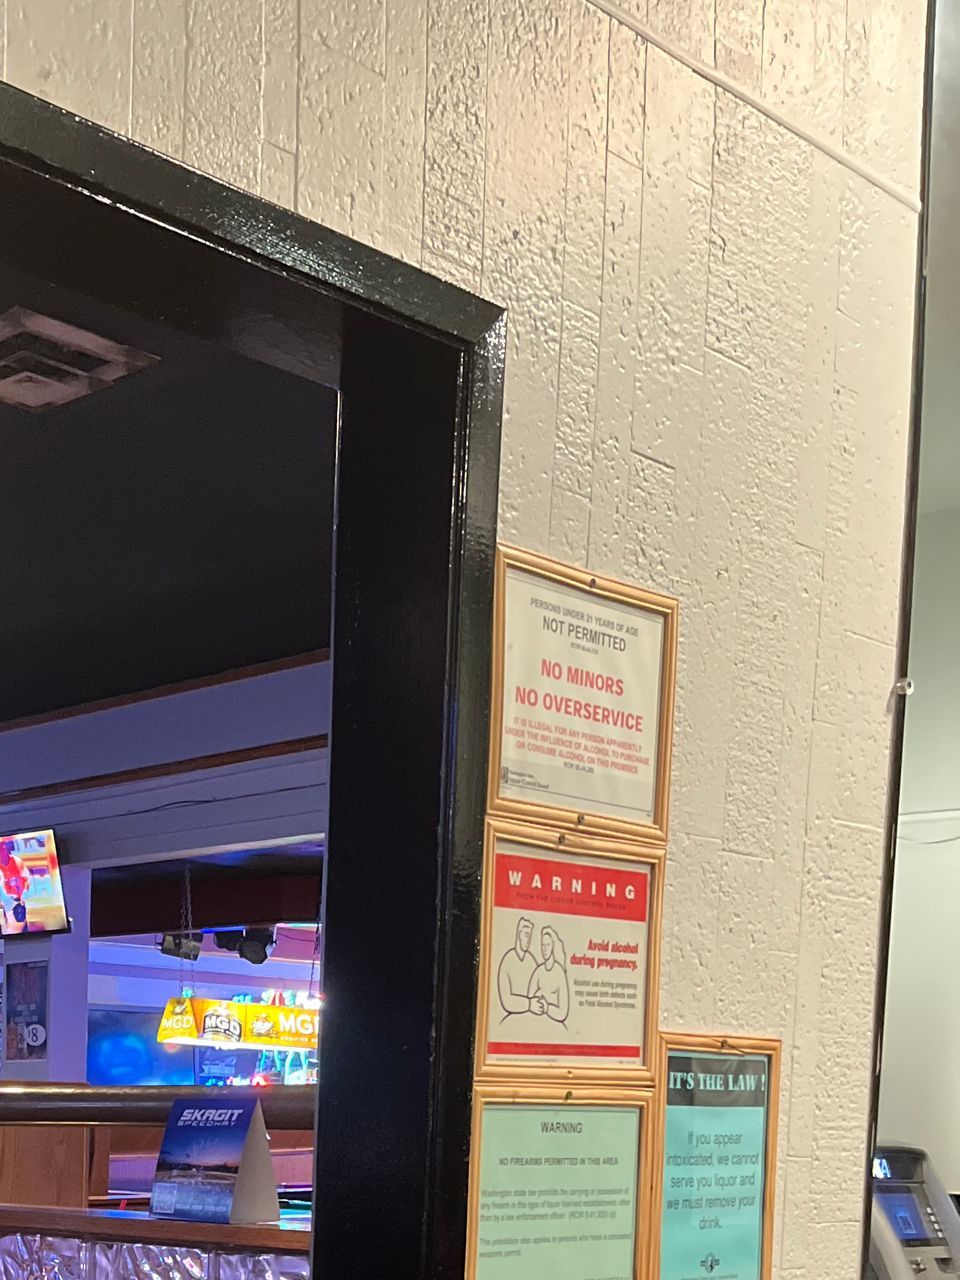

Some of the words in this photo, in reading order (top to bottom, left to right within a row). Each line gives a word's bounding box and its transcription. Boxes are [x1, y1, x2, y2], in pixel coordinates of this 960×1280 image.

[530, 597, 561, 614] PERSONS
[563, 608, 585, 620] UNDER
[586, 614, 593, 623] 21
[595, 616, 614, 631] YEARS
[616, 623, 625, 631] OF
[626, 626, 639, 636] AGE
[543, 616, 565, 635] NOT
[568, 623, 626, 652] PERMITTED
[541, 658, 562, 681] NO
[567, 665, 624, 696] MINORS
[515, 686, 538, 707] NO
[543, 692, 643, 732] OVERSERVICE
[508, 870, 635, 900] WARNING
[587, 938, 609, 952] Avoid
[611, 941, 638, 954] alcohol
[570, 953, 595, 968] during
[597, 957, 638, 972] pregnancy.
[162, 1015, 193, 1029] MGD
[204, 1014, 241, 1036] MGD
[669, 1071, 694, 1090] IT'S
[698, 1073, 724, 1091] THE
[728, 1074, 758, 1092] LAW
[761, 1074, 766, 1092] !
[180, 1109, 243, 1121] SKAGIT
[541, 1121, 583, 1134] WARNING
[688, 1130, 693, 1144] If
[695, 1134, 711, 1148] you
[714, 1132, 742, 1147] appear
[499, 1158, 509, 1166] NO
[510, 1157, 542, 1166] FIREARMS
[543, 1157, 577, 1166] PERMITTED
[588, 1157, 600, 1165] THIS
[602, 1157, 618, 1165] AREA
[666, 1152, 714, 1167] intoxicated,
[717, 1155, 729, 1165] we
[731, 1152, 759, 1165] cannot
[671, 1176, 695, 1189] serve
[696, 1176, 712, 1191] you
[714, 1174, 738, 1190] liquor
[739, 1172, 755, 1186] and
[666, 1198, 679, 1210] we
[681, 1196, 703, 1209] must
[705, 1197, 736, 1208] remove
[738, 1196, 756, 1212] your
[698, 1216, 723, 1230] drink.
